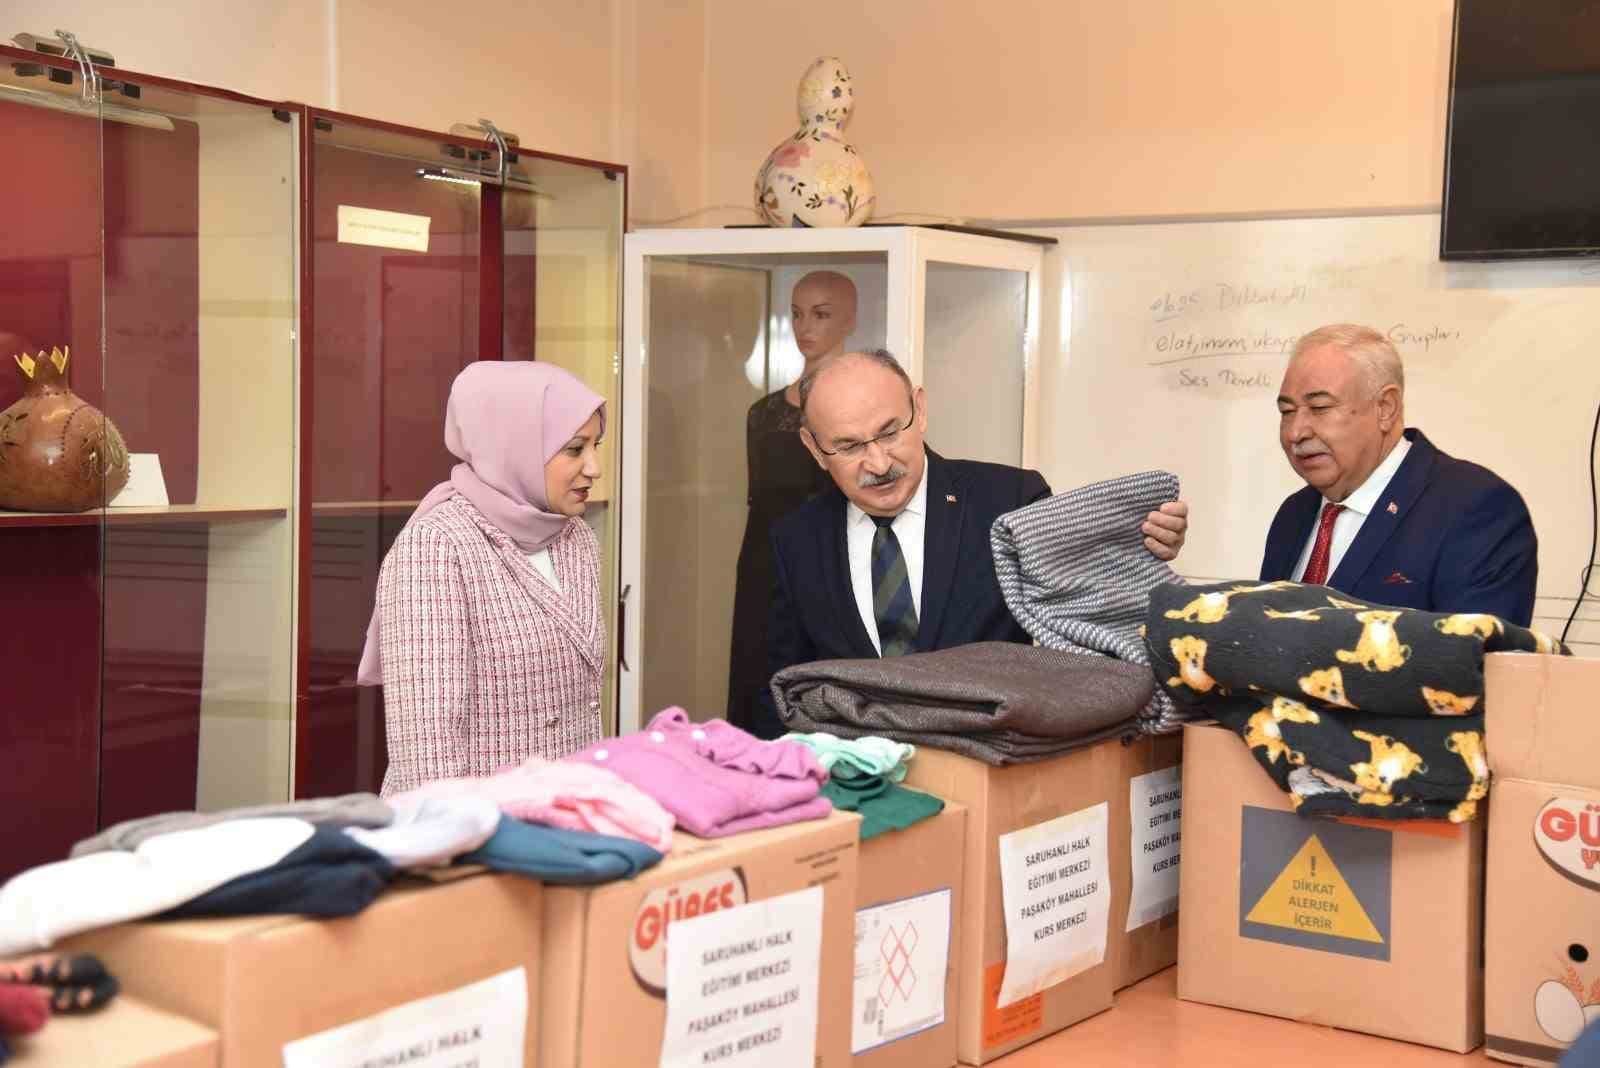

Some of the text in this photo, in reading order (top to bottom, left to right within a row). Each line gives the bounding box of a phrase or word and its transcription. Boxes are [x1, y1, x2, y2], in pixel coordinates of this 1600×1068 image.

[1025, 836, 1090, 867] SARUHANLI HALK
[1288, 895, 1339, 913] ALERJEN
[1034, 923, 1055, 942] KURS
[702, 1042, 733, 1064] KURS
